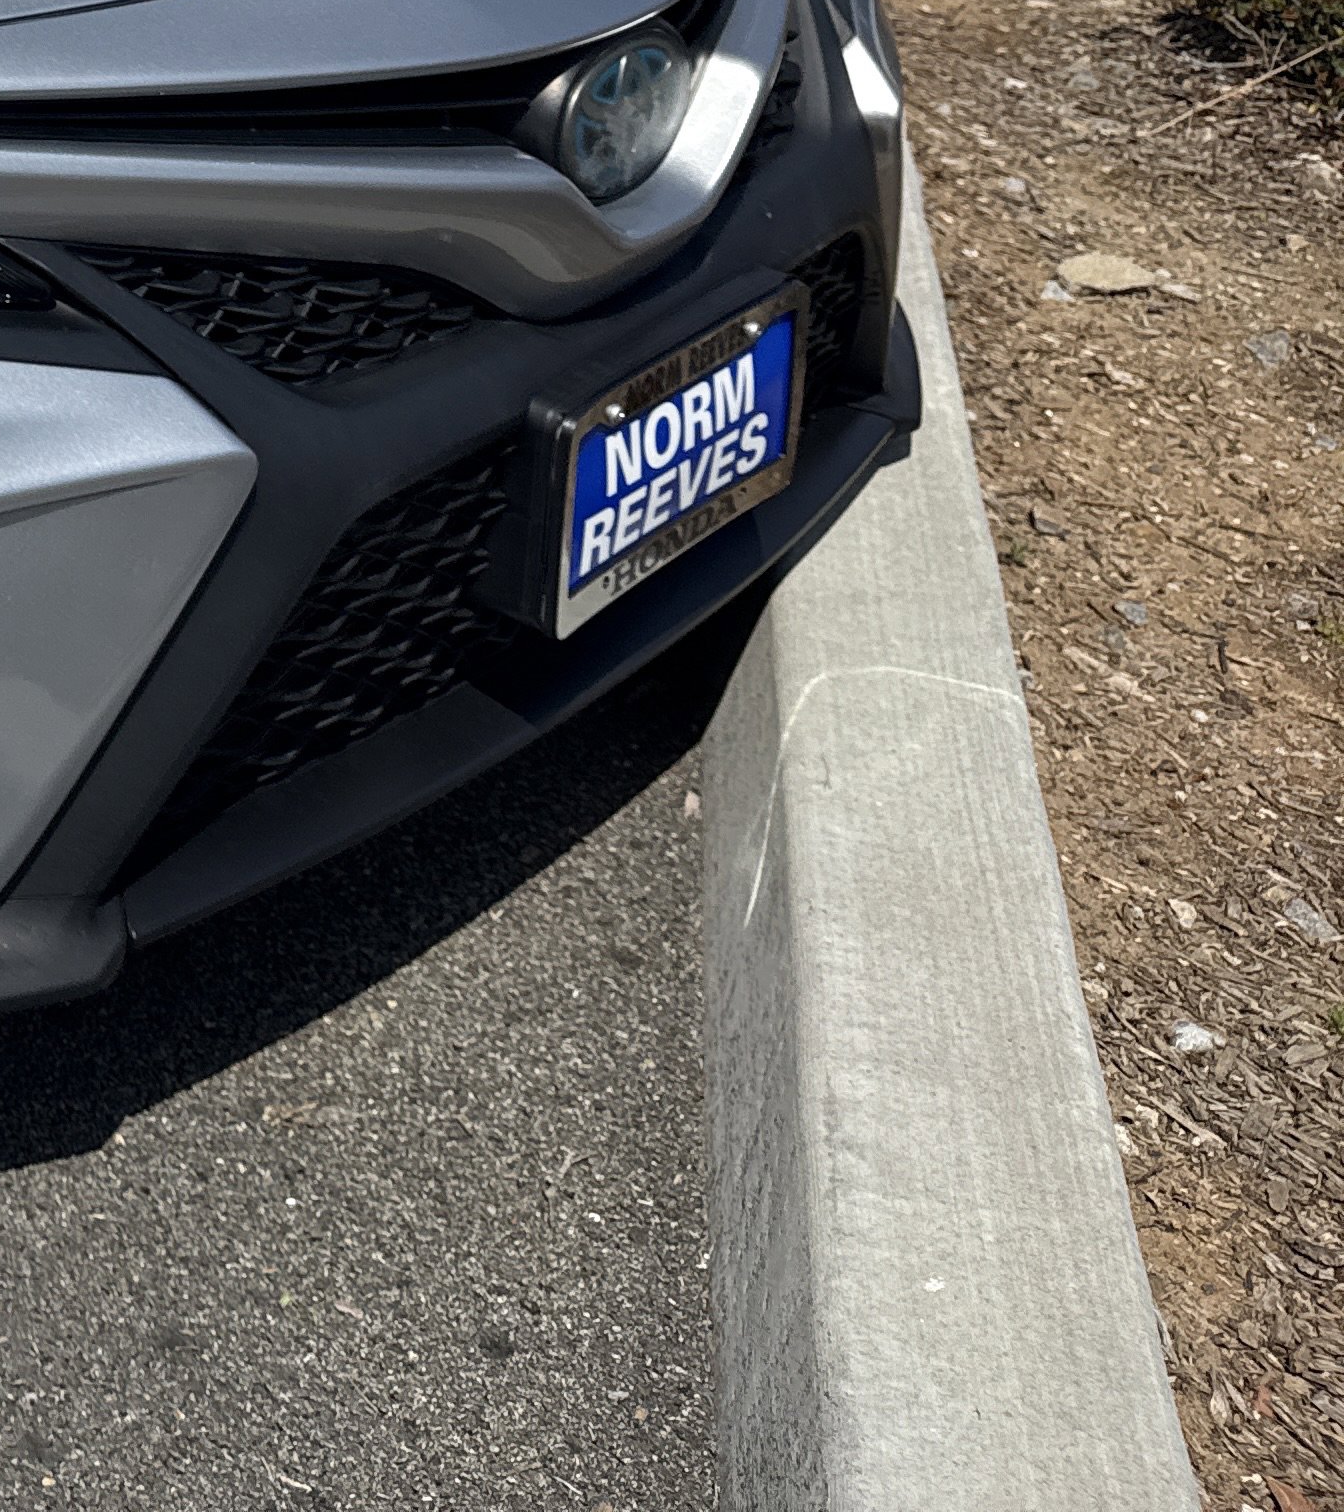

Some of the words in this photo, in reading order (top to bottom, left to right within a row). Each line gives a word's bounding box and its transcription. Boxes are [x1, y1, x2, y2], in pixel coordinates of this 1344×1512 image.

[578, 411, 770, 578] REEVES
[605, 352, 756, 497] NORM
[612, 493, 738, 596] HONDA
